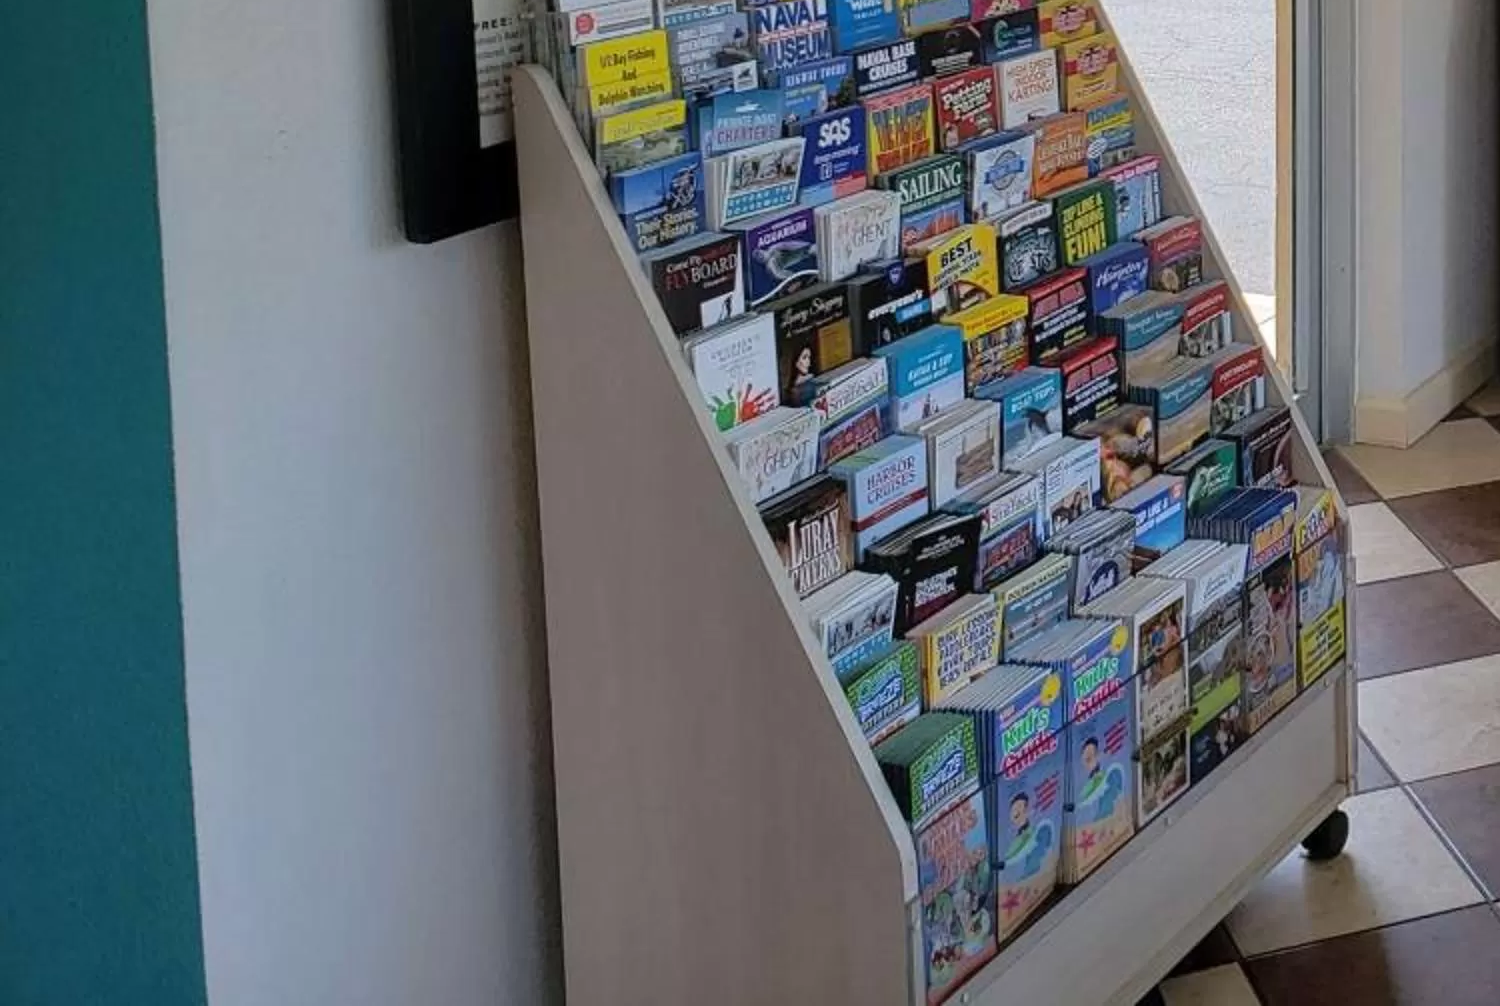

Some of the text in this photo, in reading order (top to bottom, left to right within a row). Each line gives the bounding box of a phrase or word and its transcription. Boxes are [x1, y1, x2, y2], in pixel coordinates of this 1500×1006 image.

[856, 41, 917, 71] NAVAL BASE
[868, 58, 908, 81] CRUISES
[818, 116, 852, 148] SAS
[898, 160, 962, 205] SAILING
[757, 220, 808, 248] AQUARIUM
[1066, 225, 1107, 264] FUN!
[940, 237, 973, 269] BEST
[866, 454, 916, 491] HARBOR
[866, 472, 916, 505] CRUISES
[787, 508, 840, 567] LURAY
[791, 548, 842, 593] CAVERNS
